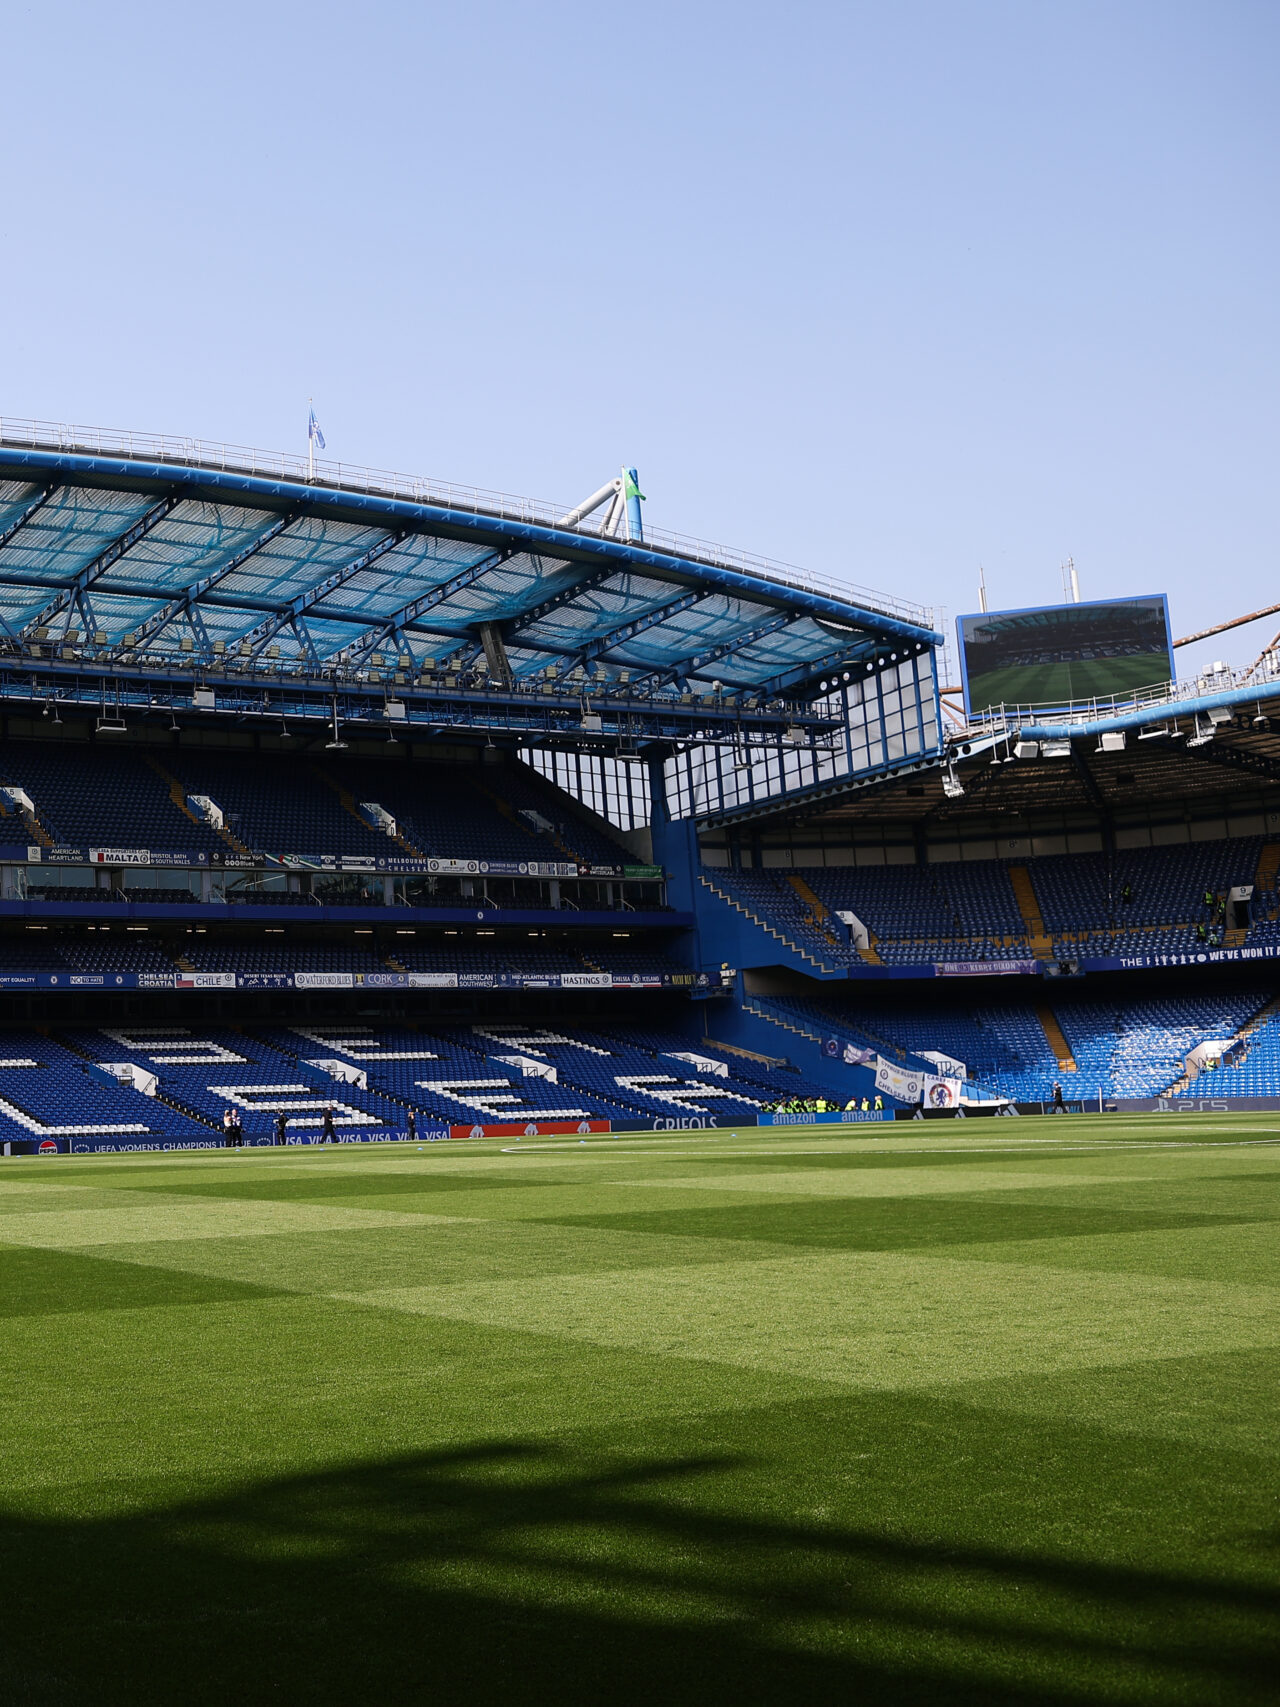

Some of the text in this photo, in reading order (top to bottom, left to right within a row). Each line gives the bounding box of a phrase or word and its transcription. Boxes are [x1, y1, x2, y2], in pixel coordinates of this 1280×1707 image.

[106, 854, 139, 862] MALTA
[1120, 947, 1274, 967] THE WE'VE WON IT
[196, 978, 221, 986] CHILE
[305, 976, 351, 985] WATERFORD BLUES
[368, 975, 393, 984] CORK
[881, 1060, 918, 1079] CYPRUS BLUES
[878, 1081, 906, 1101] CHELSEA
[1178, 1100, 1229, 1112] PS5
[772, 1112, 816, 1125] amazon
[841, 1108, 884, 1122] amazon
[653, 1117, 717, 1130] GRIFOLS
[337, 1134, 362, 1144] VISA
[366, 1133, 391, 1143] VISA
[395, 1132, 420, 1142] VIA
[424, 1131, 448, 1141] VISA
[95, 1145, 117, 1153] UEFA
[118, 1144, 160, 1153] WOMEN'S
[163, 1141, 217, 1151] CHAMPIONS
